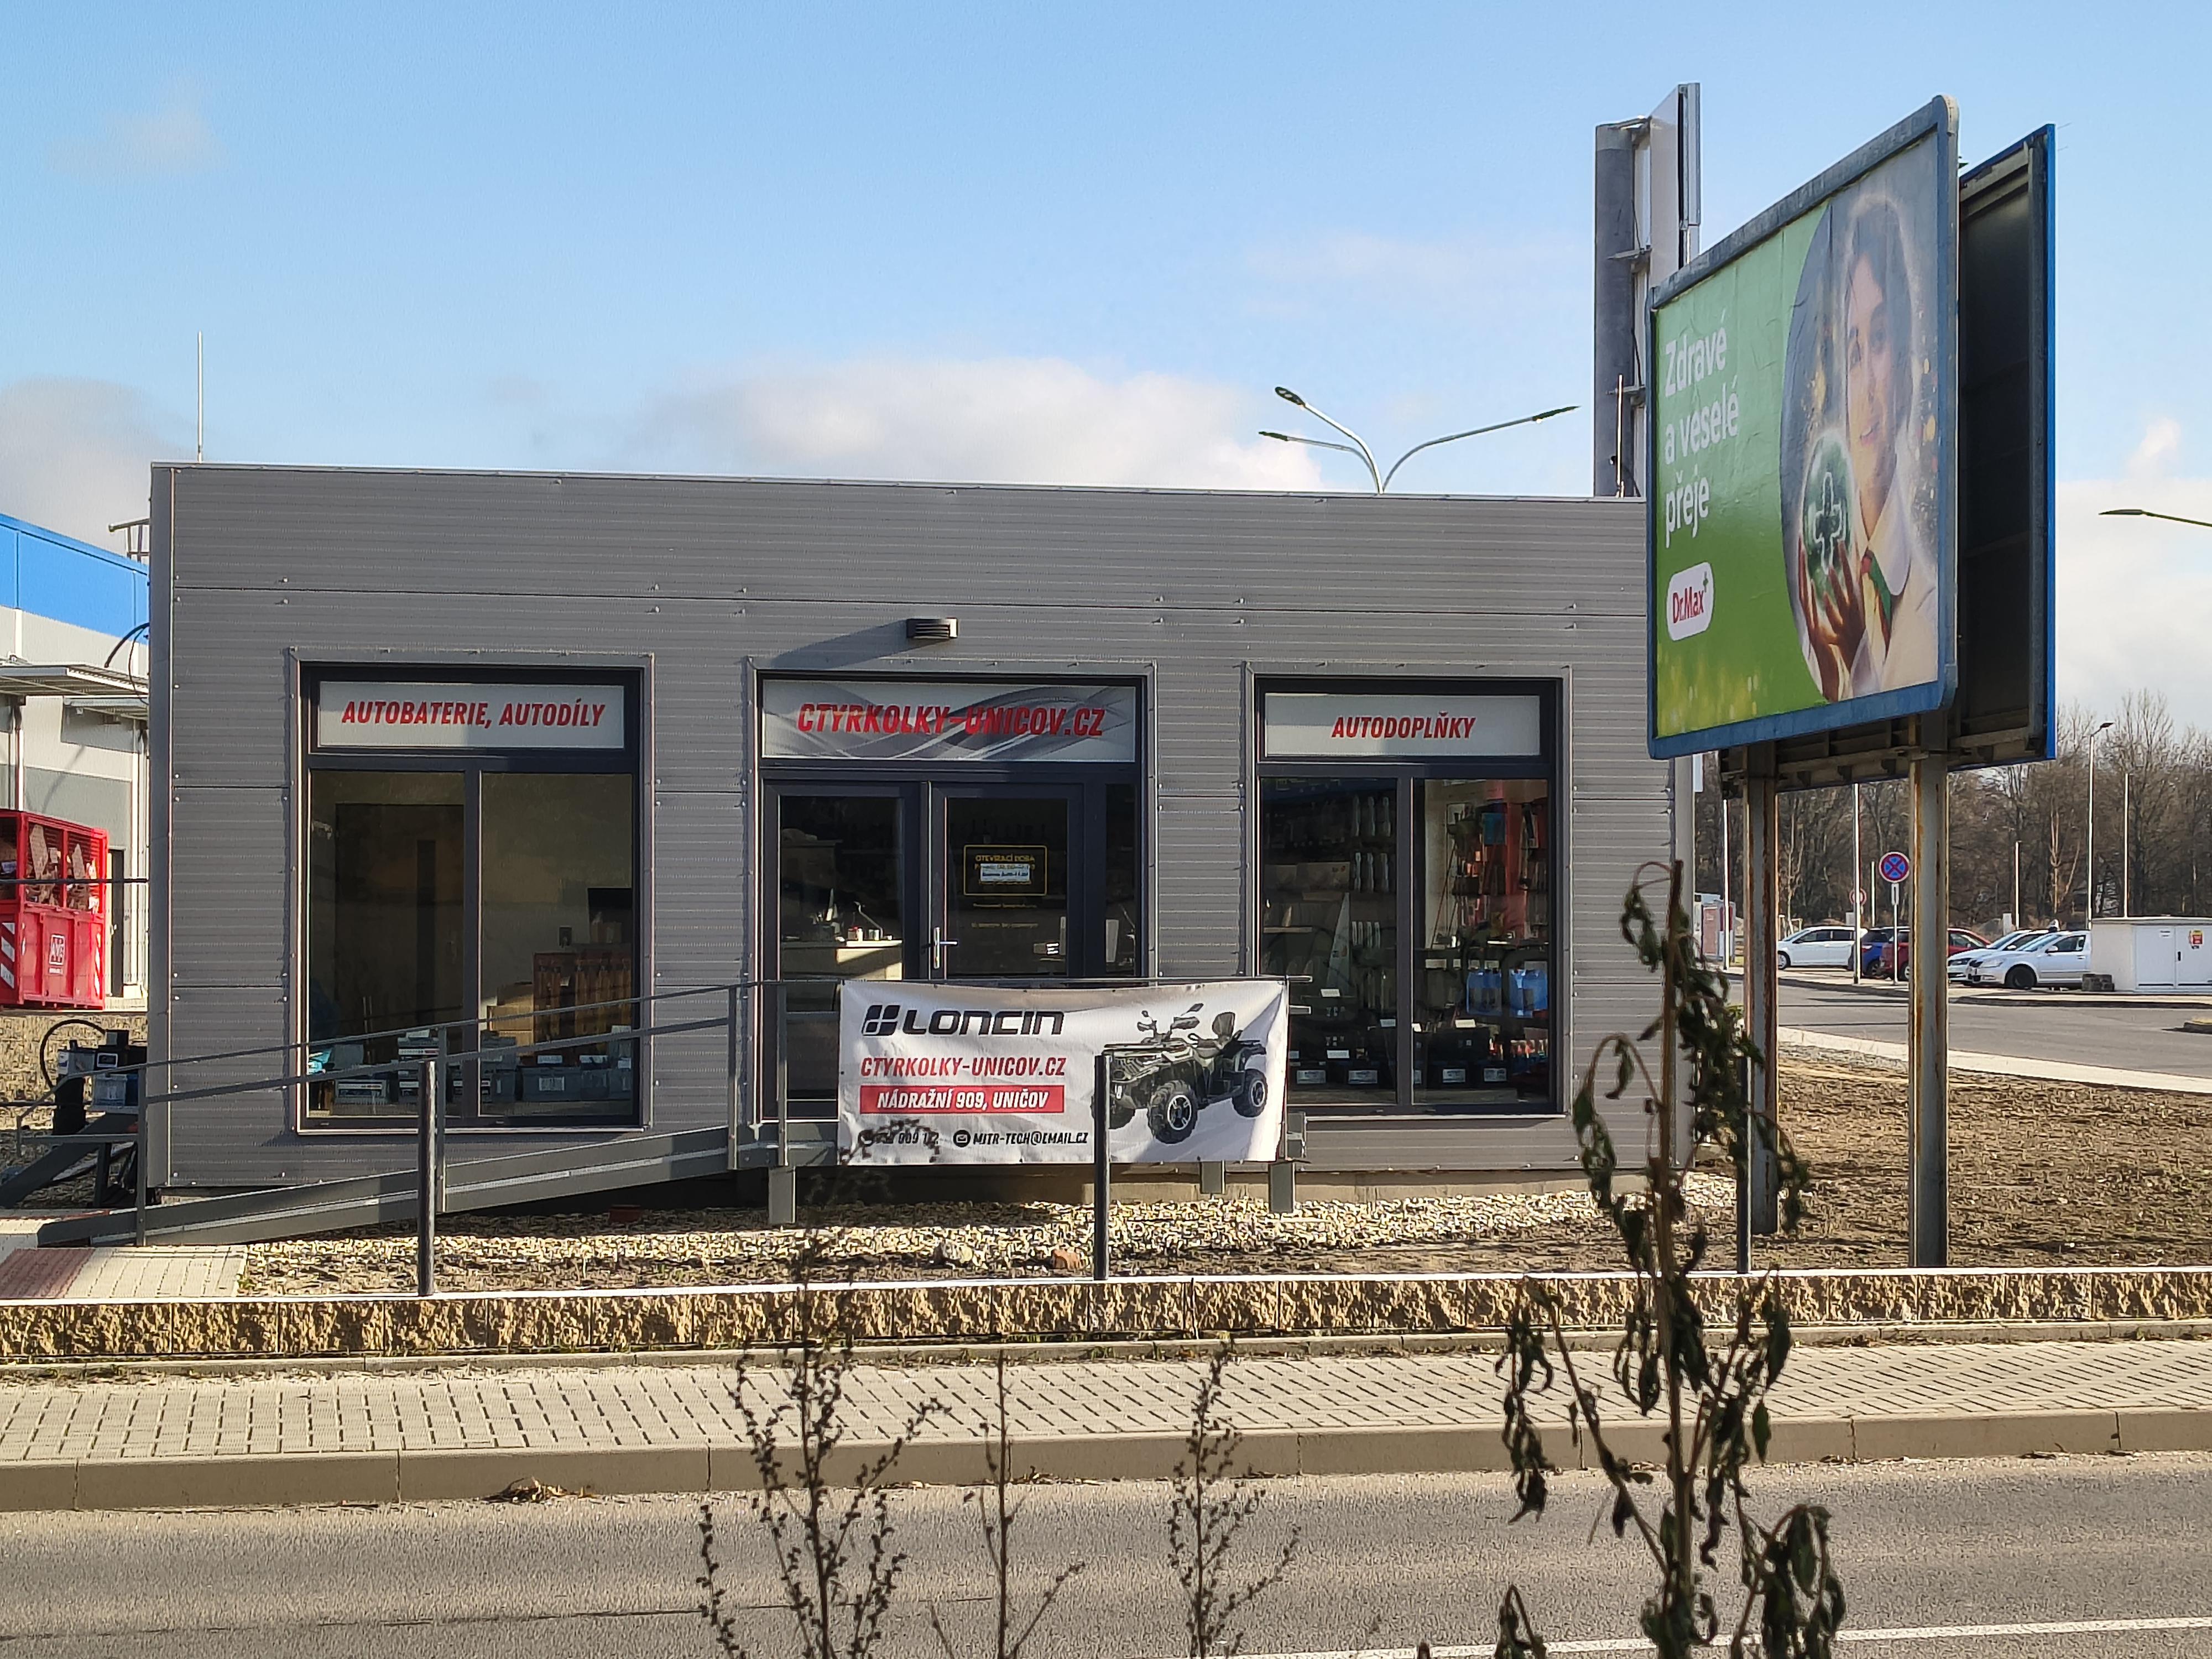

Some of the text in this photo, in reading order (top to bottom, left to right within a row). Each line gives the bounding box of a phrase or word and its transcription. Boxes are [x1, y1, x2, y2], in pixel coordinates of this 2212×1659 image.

[1665, 309, 1727, 397] Zdravé
[1665, 375, 1739, 465] a veselé
[1666, 464, 1710, 548] přeje
[341, 698, 606, 729] AUTOBATERIE, AUTODÍLY
[797, 702, 1106, 737] CTYRKOLKY-UNICOV.CZ
[1331, 711, 1477, 739] AUTODOPLŇKY
[860, 1057, 1066, 1077] CTYRKOLKY-UNICOV.CZ
[877, 1087, 1048, 1111] NÁDRAŽNÍ 909, UNIČOV
